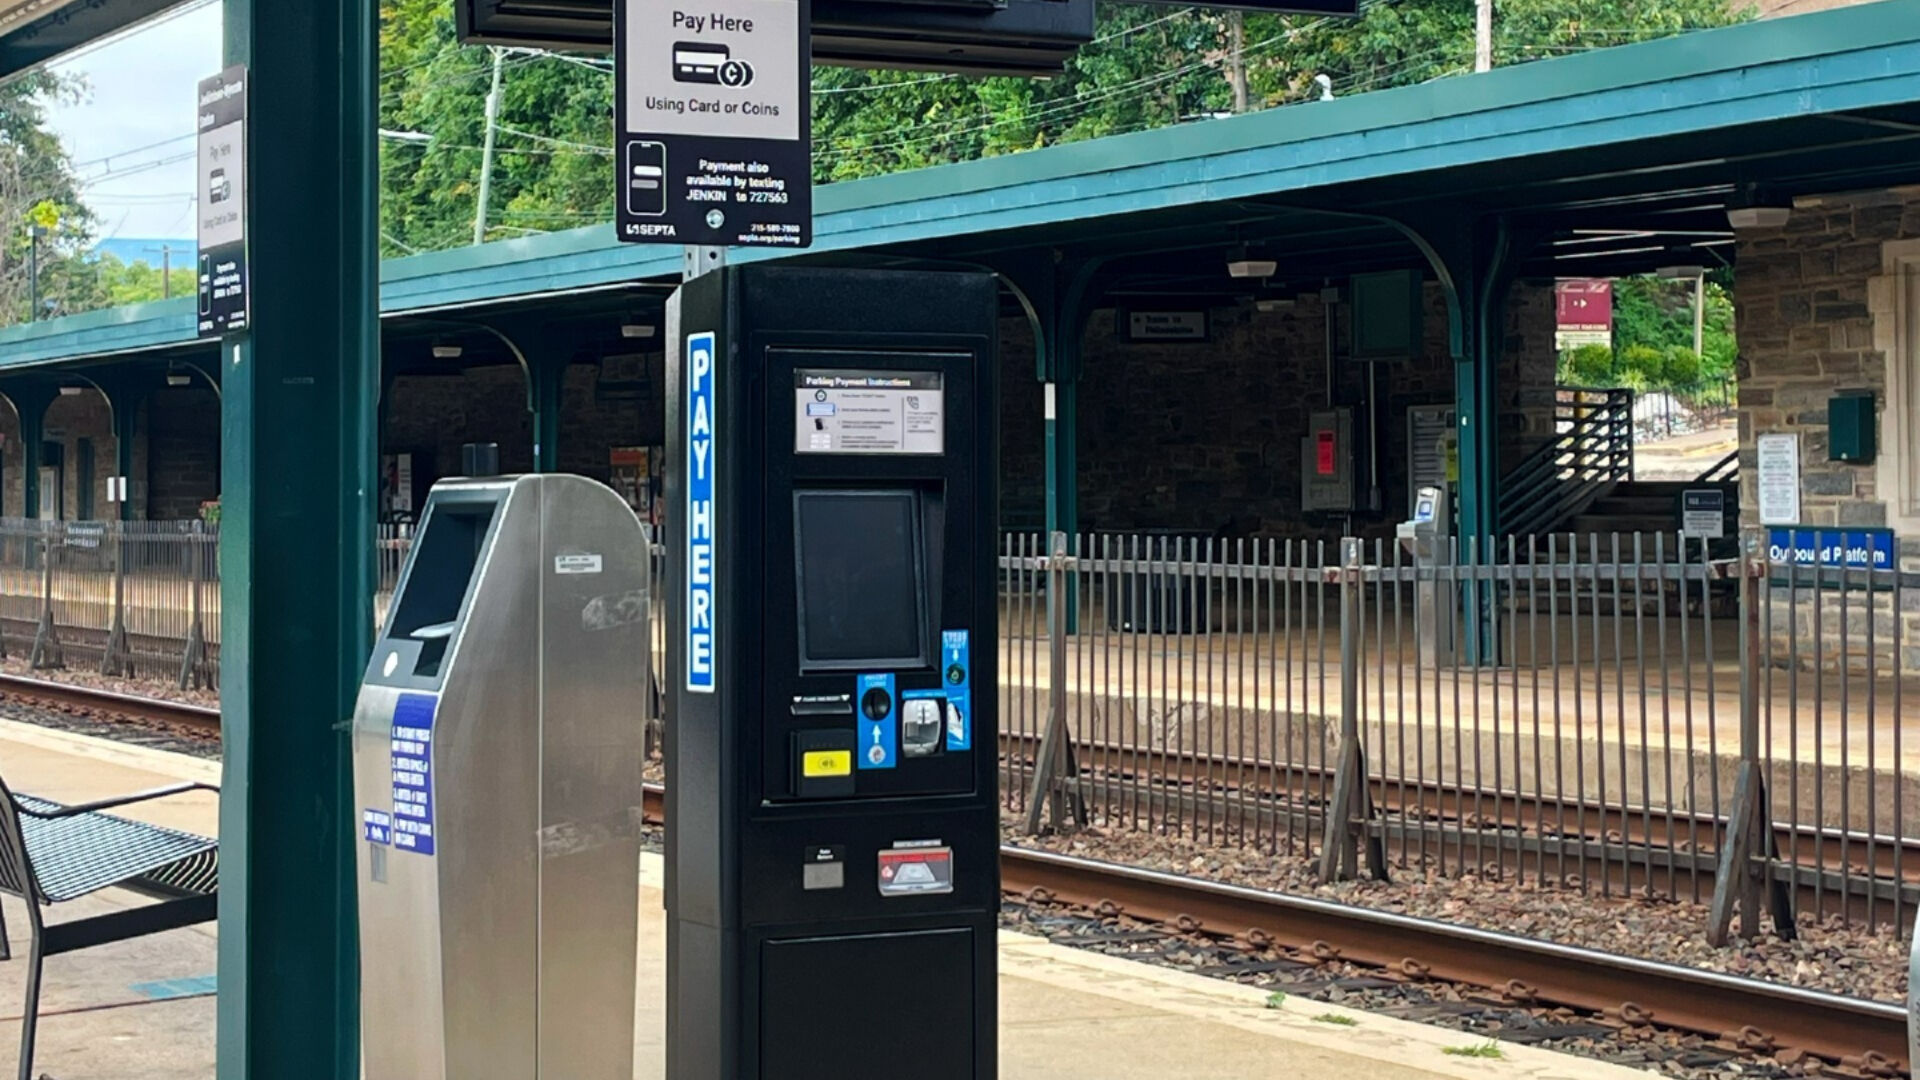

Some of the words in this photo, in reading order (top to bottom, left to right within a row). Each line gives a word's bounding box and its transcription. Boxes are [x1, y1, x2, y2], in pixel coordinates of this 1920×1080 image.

[673, 11, 705, 33] Pay
[711, 14, 754, 32] Here
[646, 97, 685, 114] Using
[688, 99, 721, 113] Card
[724, 102, 739, 113] or
[743, 102, 780, 117] Coins
[699, 159, 745, 174] Payment
[747, 161, 770, 172] also
[686, 175, 733, 187] available
[734, 177, 747, 189] by
[749, 177, 785, 190] texting
[686, 189, 728, 202] JENKIN
[736, 191, 748, 202] to
[749, 191, 789, 204] 727563
[640, 224, 676, 236] SEPTA
[806, 376, 835, 387] Parking
[835, 377, 868, 388] Payment
[692, 348, 711, 480] PAY
[1833, 547, 1886, 564] Patfom
[692, 499, 711, 674] HERE
